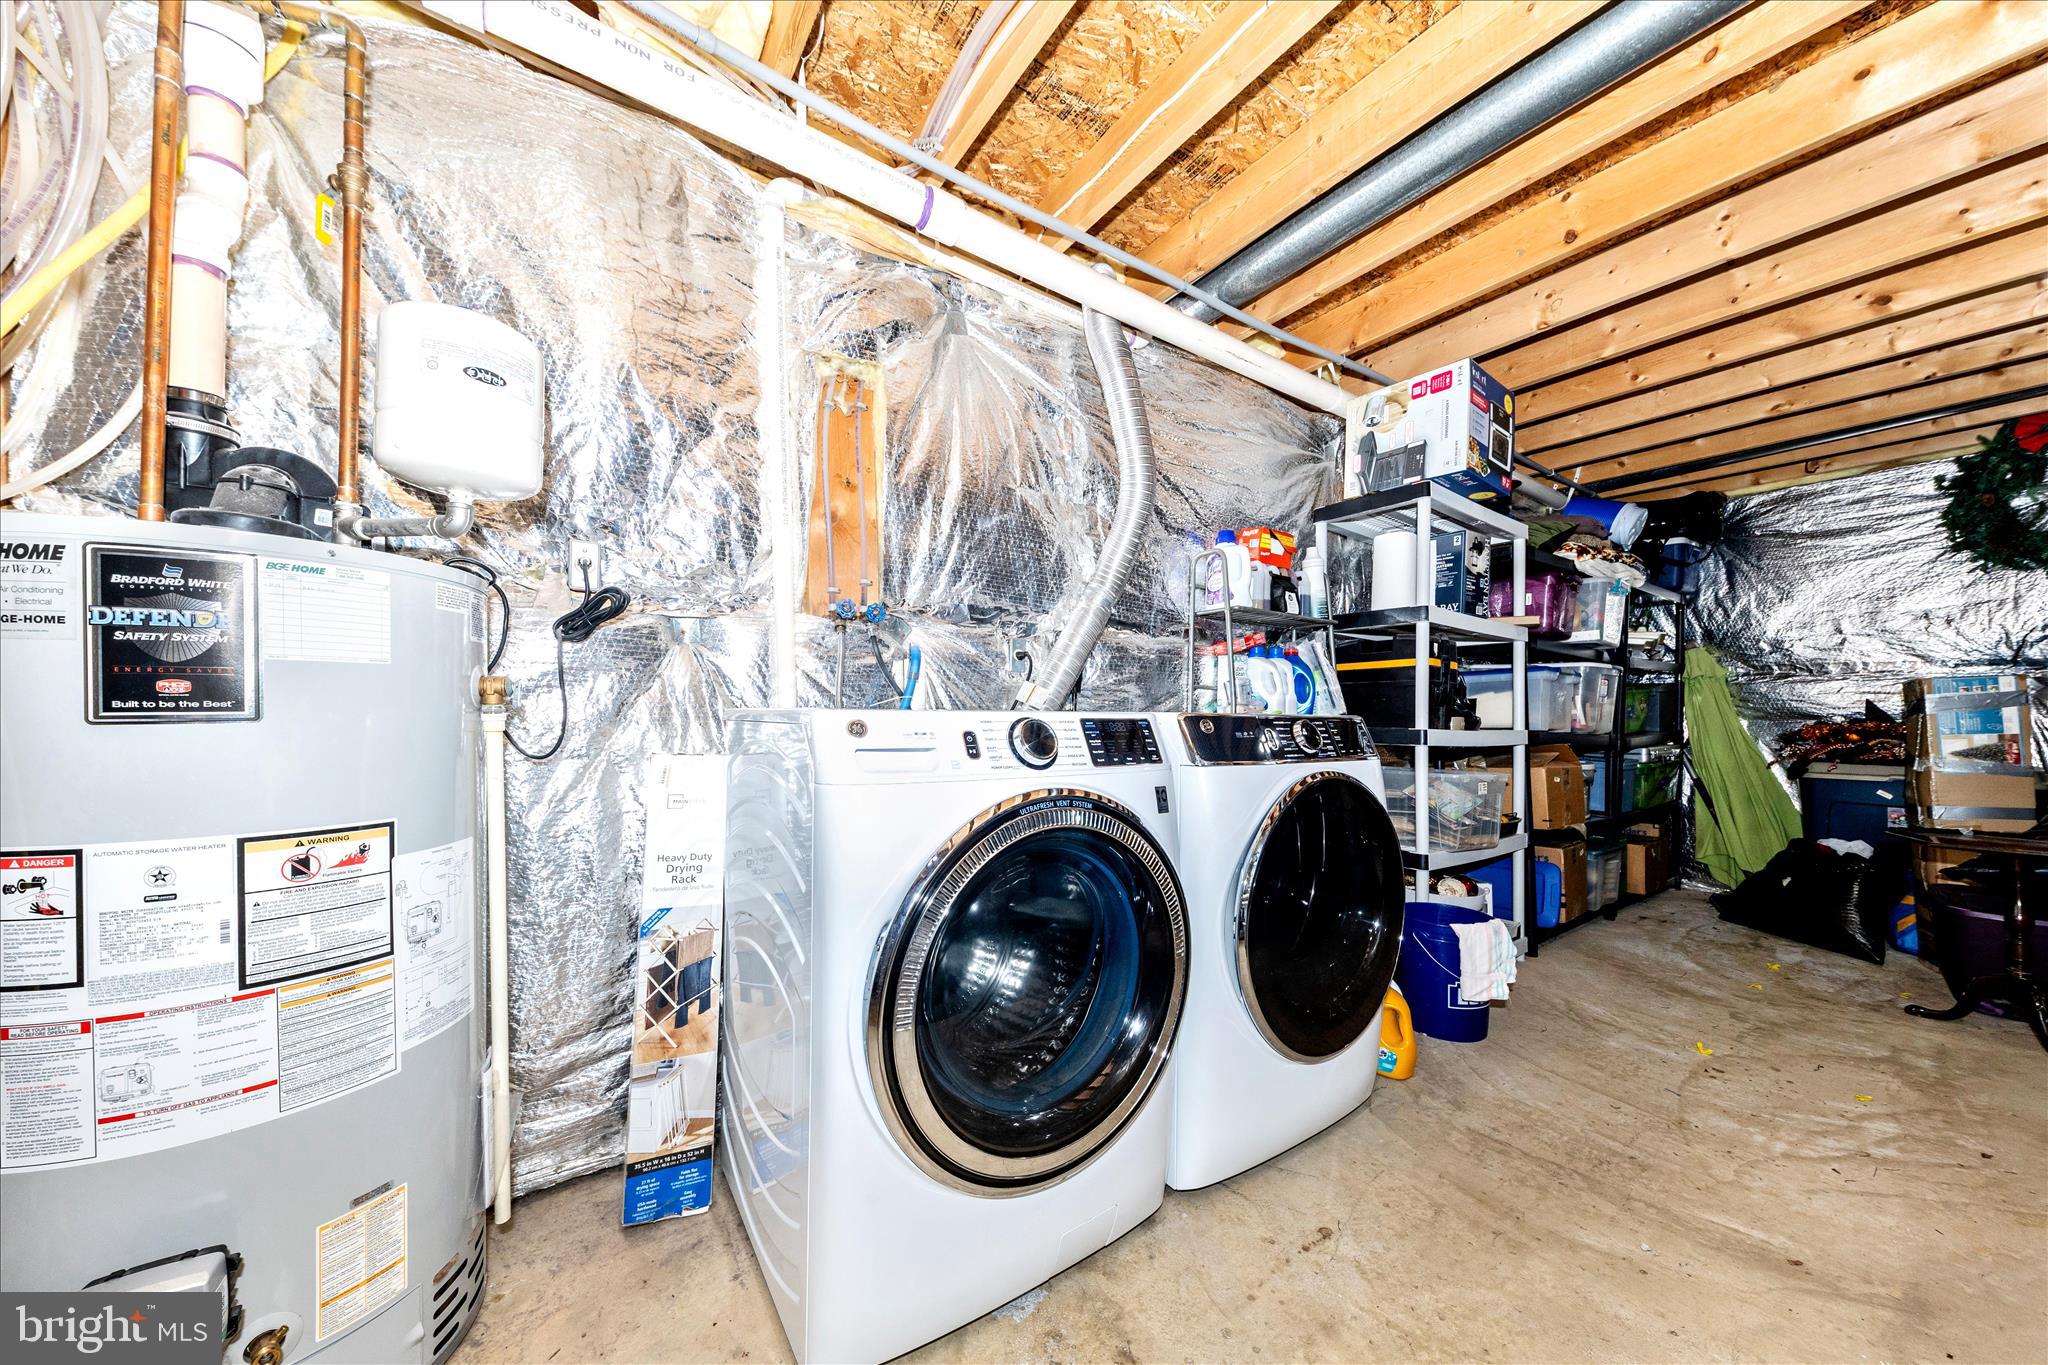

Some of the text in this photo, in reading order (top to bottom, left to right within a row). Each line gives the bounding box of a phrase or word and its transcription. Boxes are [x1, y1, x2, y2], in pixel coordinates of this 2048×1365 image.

[615, 38, 651, 62] NON
[664, 60, 696, 82] FOR
[0, 543, 66, 560] HOME
[12, 564, 28, 573] We
[291, 564, 326, 575] HOME
[110, 574, 232, 589] BRADFORD WHITE
[11, 585, 64, 595] Conditioning
[15, 597, 52, 605] Electrical
[113, 631, 229, 643] SAFETY SYSTEM
[112, 700, 139, 708] Built
[142, 700, 156, 708] to
[158, 700, 176, 708] be
[178, 700, 199, 708] the
[1020, 802, 1054, 815] ULTRAFRESH
[1072, 800, 1093, 809] SYSTEM
[307, 835, 350, 845] WARNING
[93, 850, 134, 858] AUTOMATIC
[657, 852, 713, 864] Heavy Duty
[23, 859, 65, 867] DANGER
[666, 864, 703, 875] Drying
[671, 874, 697, 884] Rack
[332, 971, 356, 980] WARNING
[149, 1000, 227, 1017] OPERATING INSTRUCTIONS
[152, 1107, 169, 1115] TURN
[170, 1104, 183, 1112] OFF
[184, 1101, 197, 1109] GAS
[205, 1090, 239, 1103] APPLIANCE
